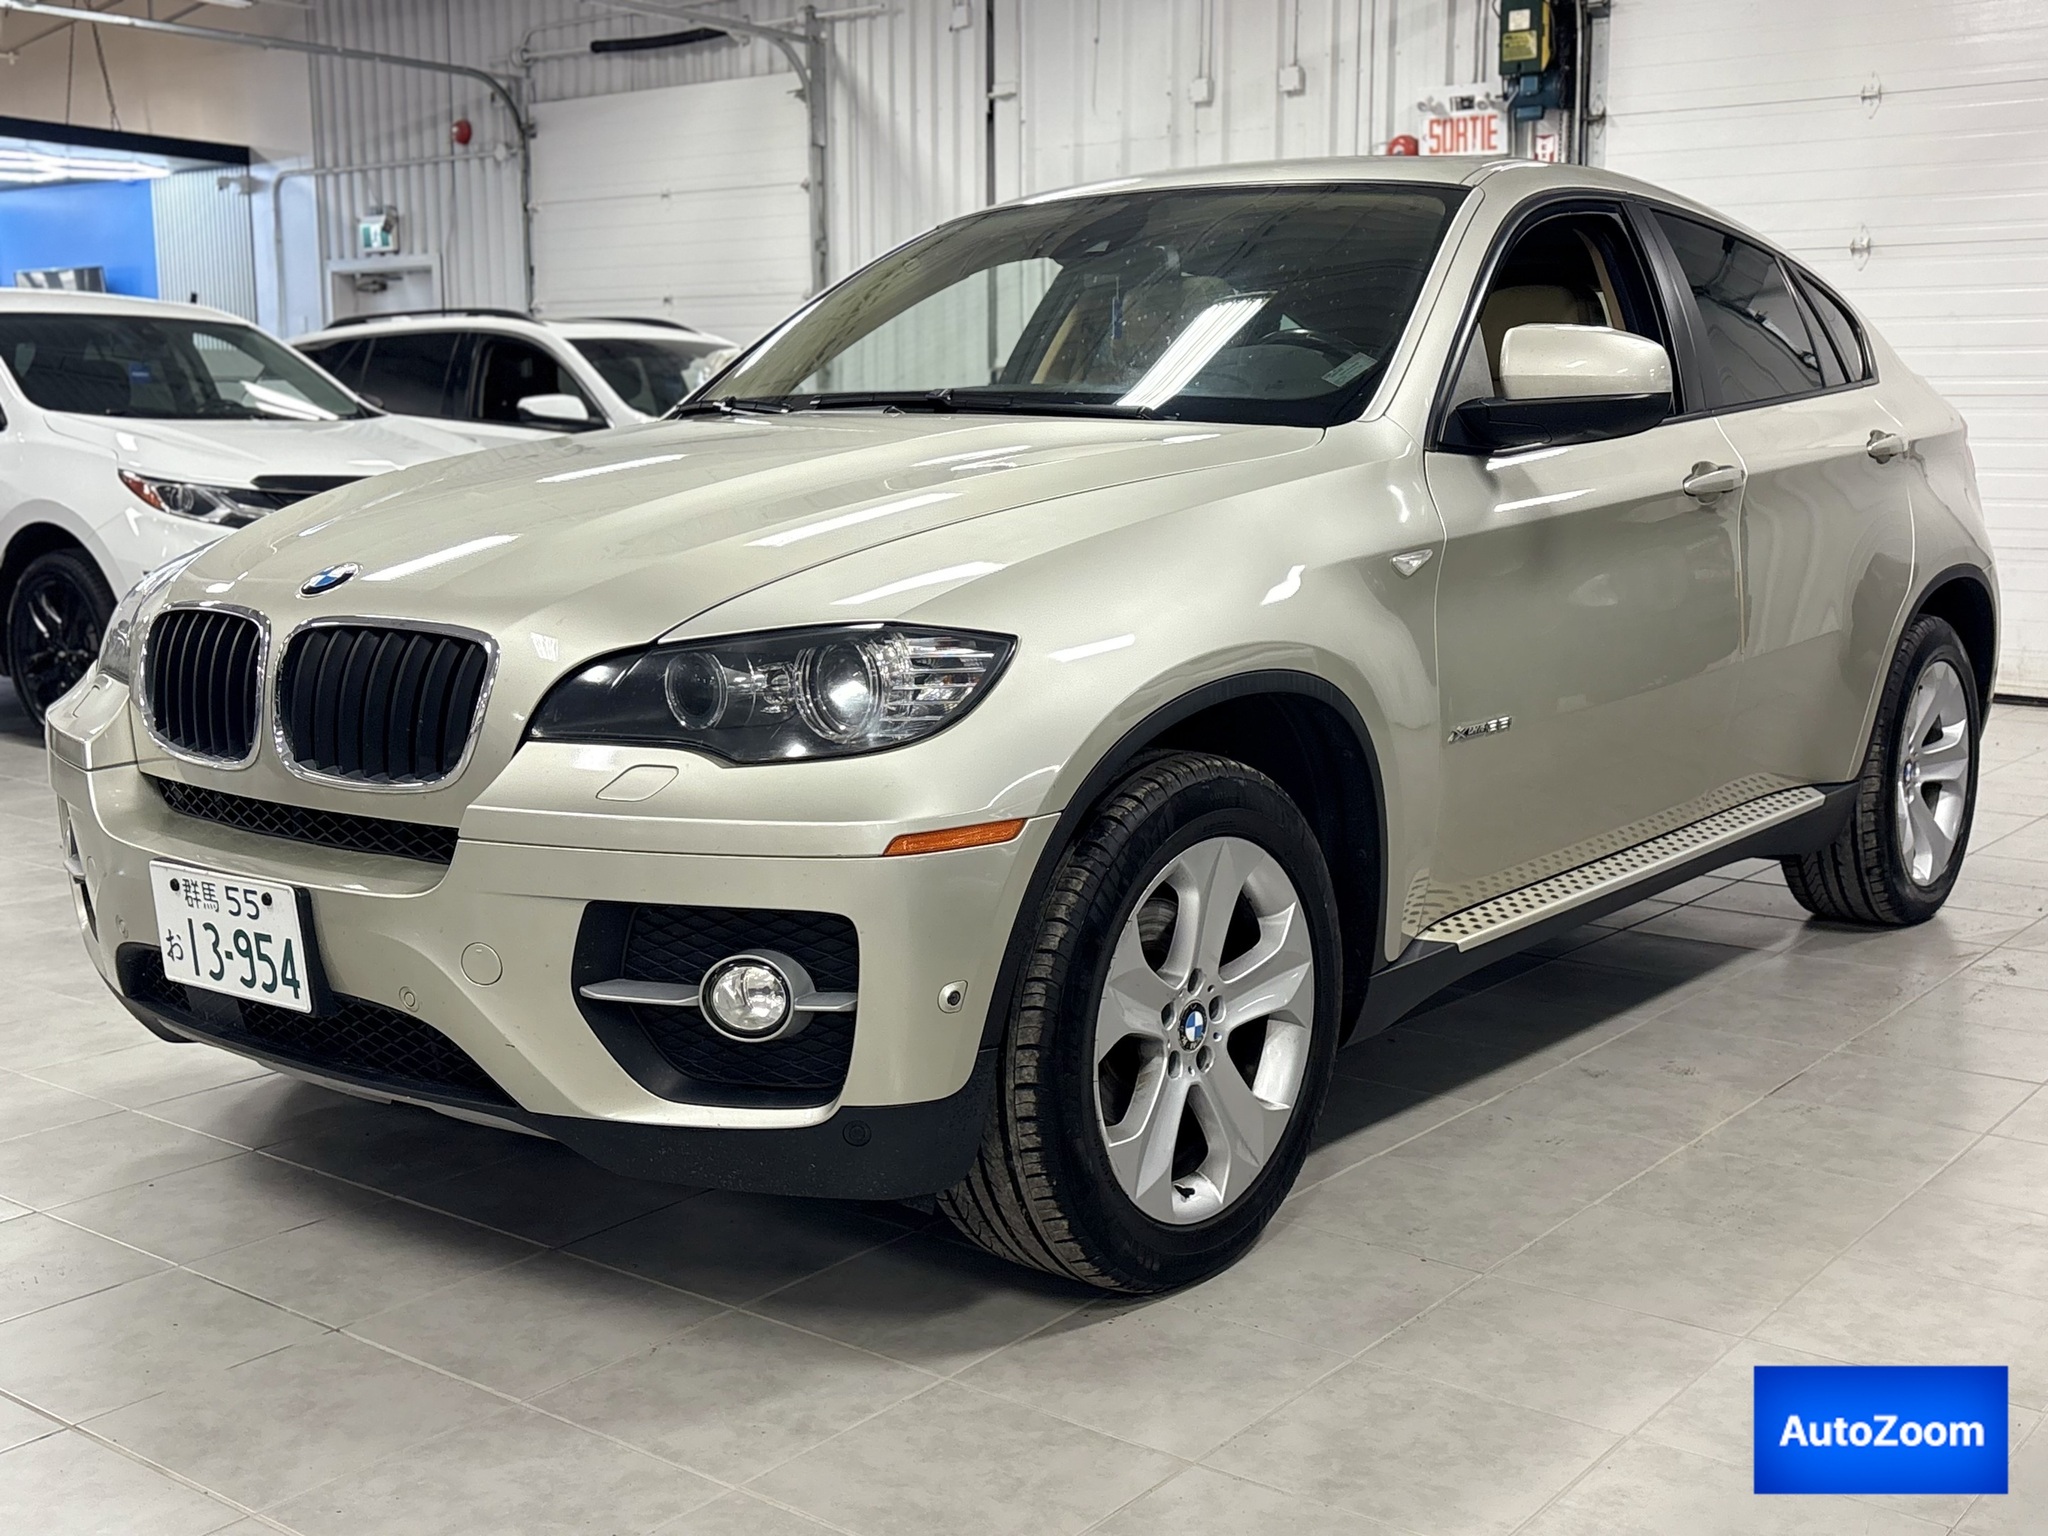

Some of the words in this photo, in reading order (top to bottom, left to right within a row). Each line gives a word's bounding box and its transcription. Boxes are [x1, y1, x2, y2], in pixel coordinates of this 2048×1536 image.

[1429, 114, 1498, 154] SORTIE
[182, 878, 219, 912] 群馬
[225, 886, 260, 920] 55
[166, 929, 184, 961] お
[187, 918, 300, 999] 13-954
